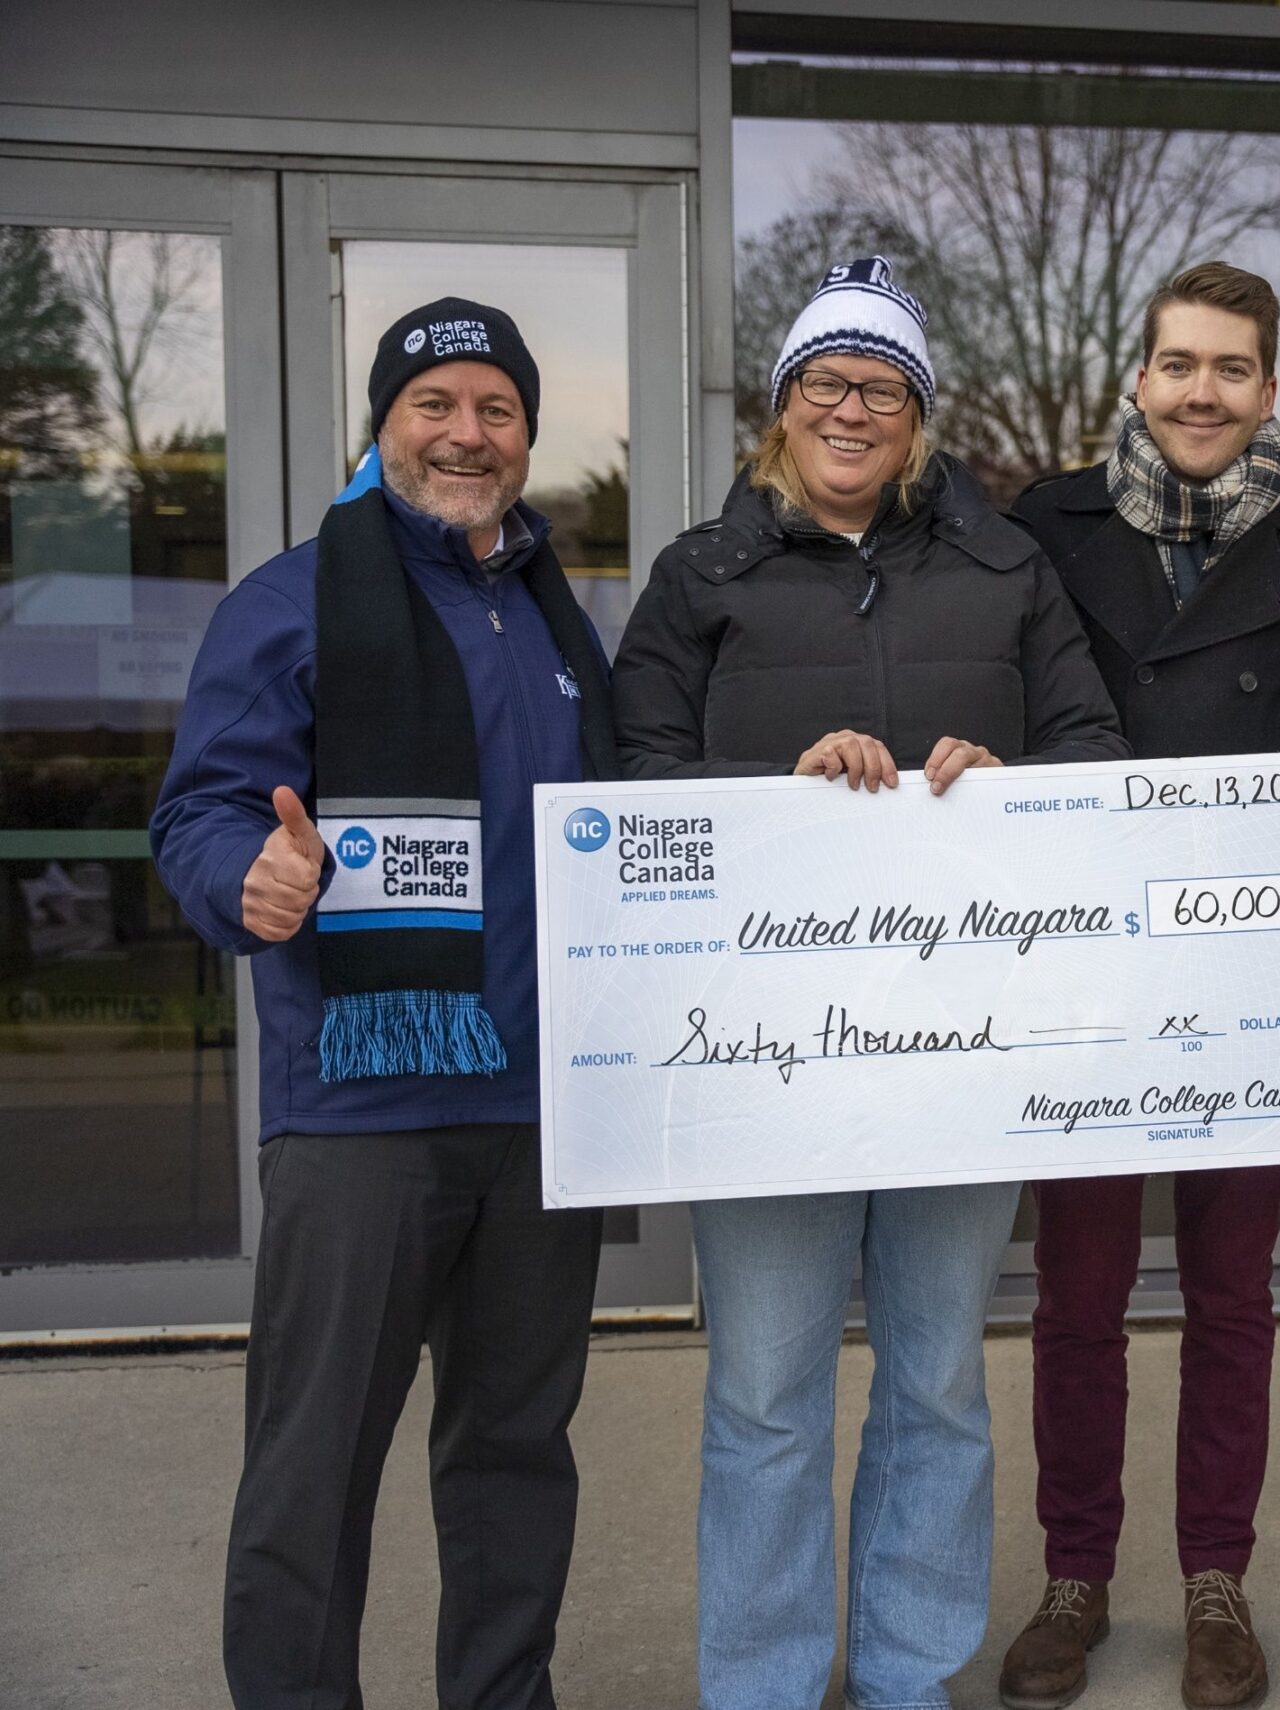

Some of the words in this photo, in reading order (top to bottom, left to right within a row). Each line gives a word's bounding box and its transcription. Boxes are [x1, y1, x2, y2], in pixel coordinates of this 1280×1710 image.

[428, 320, 485, 335] Niagara
[407, 333, 423, 348] nc
[431, 329, 488, 345] College
[434, 341, 491, 356] Canada
[1004, 799, 1062, 814] CHEQUE
[1066, 797, 1104, 810] DATE:
[571, 821, 604, 839] nc
[618, 814, 713, 841] Niagara
[341, 839, 370, 857] nc
[382, 835, 469, 860] Niagara
[618, 837, 714, 864] College
[382, 856, 469, 880] College
[619, 861, 715, 884] Canada
[382, 876, 468, 898] Canada
[621, 891, 666, 903] APPLIED
[670, 889, 719, 901] DREAMS.
[737, 905, 860, 949] United
[868, 903, 949, 961] Way
[958, 899, 1113, 956] Niagara
[1124, 911, 1141, 937] $
[568, 946, 593, 959] PAY
[598, 945, 617, 957] TO
[621, 943, 649, 956] THE
[654, 941, 703, 955] ORDER
[708, 940, 731, 952] OF:
[661, 1007, 806, 1084] Sixty
[812, 1004, 1013, 1057] thousand
[1179, 1041, 1203, 1052] 100
[570, 1052, 637, 1067] AMOUNT:
[1021, 1093, 1132, 1134] Niagara
[1140, 1083, 1237, 1126] College
[1147, 1127, 1215, 1142] SIGNATURE
